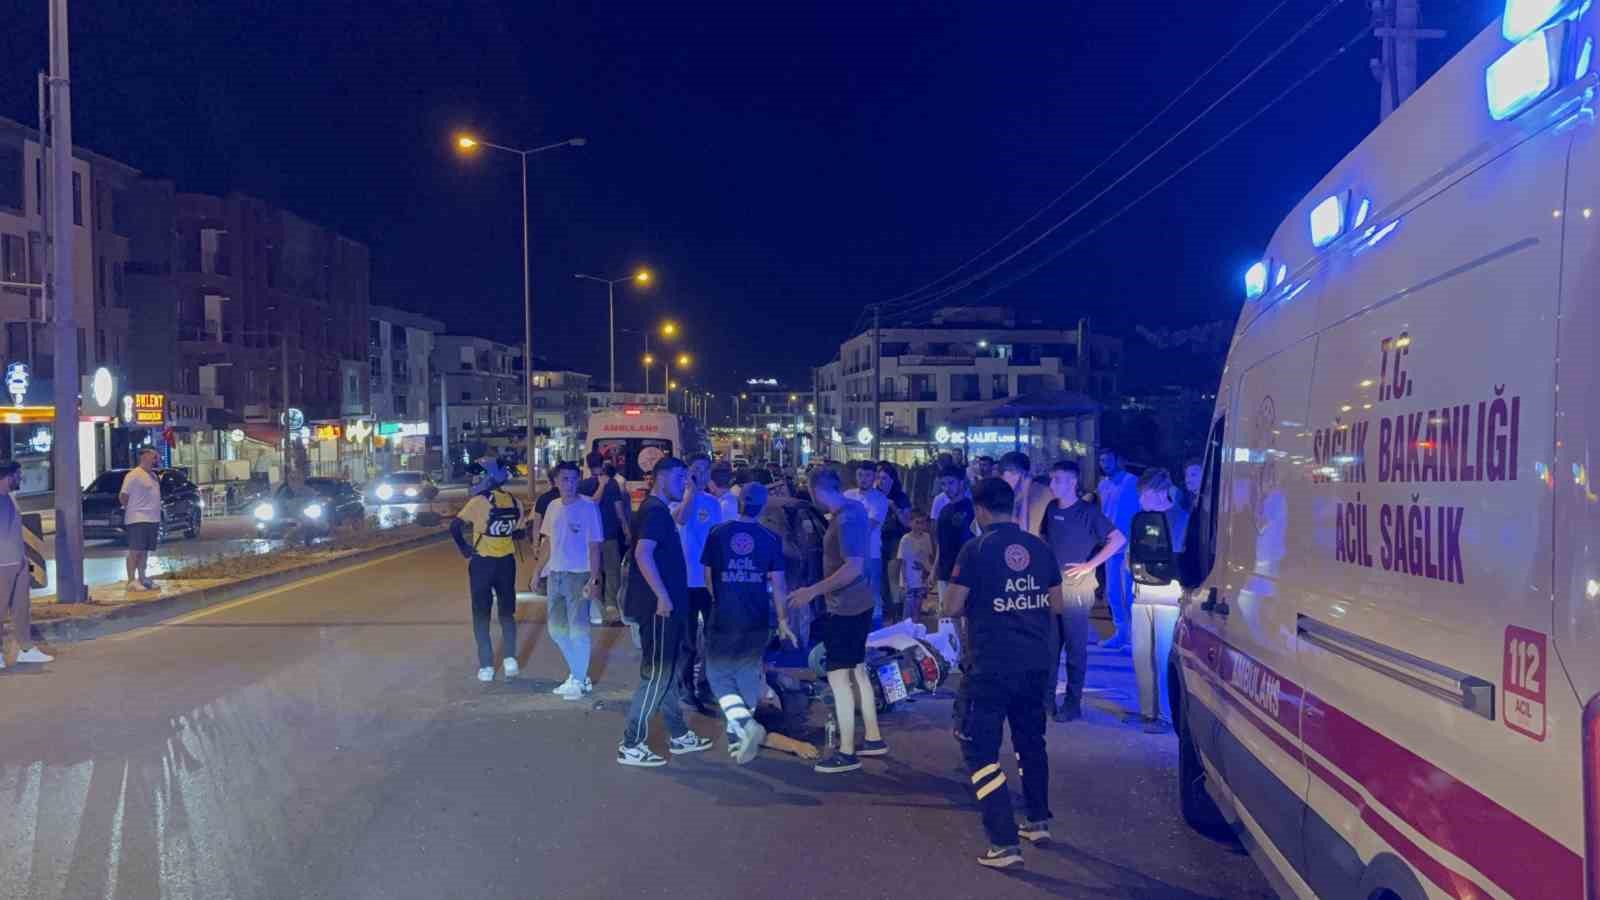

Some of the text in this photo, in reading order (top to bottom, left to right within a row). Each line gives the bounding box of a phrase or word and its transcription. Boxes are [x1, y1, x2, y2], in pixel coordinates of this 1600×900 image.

[1378, 332, 1412, 401] T.C.
[1313, 383, 1520, 483] SAĞLIK BAKANLIĞI
[1335, 491, 1465, 585] ACİL SAĞLIK
[993, 593, 1050, 613] SAĞLIK
[1005, 574, 1040, 593] ACİL
[1510, 637, 1540, 693] 112
